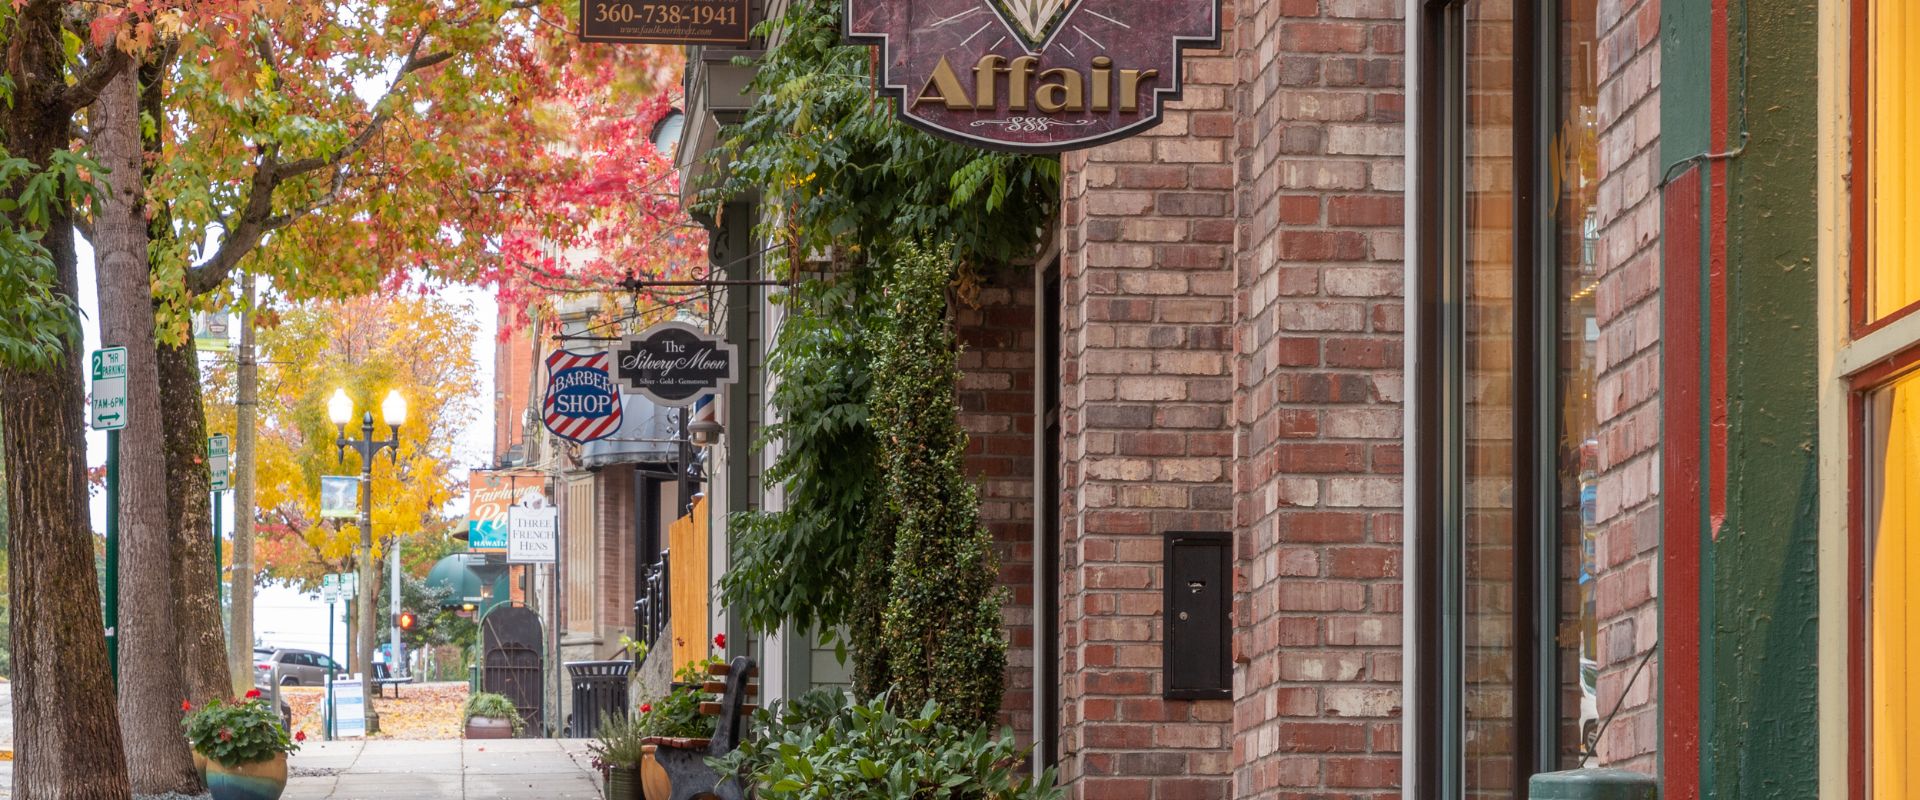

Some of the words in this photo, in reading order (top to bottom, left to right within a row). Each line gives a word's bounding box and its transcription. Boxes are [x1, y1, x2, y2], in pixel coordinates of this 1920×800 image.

[595, 3, 737, 25] 360-738-1941
[910, 54, 1159, 113] Affair
[662, 340, 685, 353] The
[110, 353, 119, 363] HR
[621, 349, 676, 376] Silvery
[674, 348, 727, 370] Moon
[93, 355, 101, 376] 2
[103, 365, 125, 377] PARKING
[555, 371, 611, 394] BARBER
[94, 397, 124, 410] 7AM-6PM
[557, 394, 610, 413] SHOP
[515, 518, 552, 528] THREE
[512, 529, 555, 539] FRENCH
[520, 541, 548, 551] HENS
